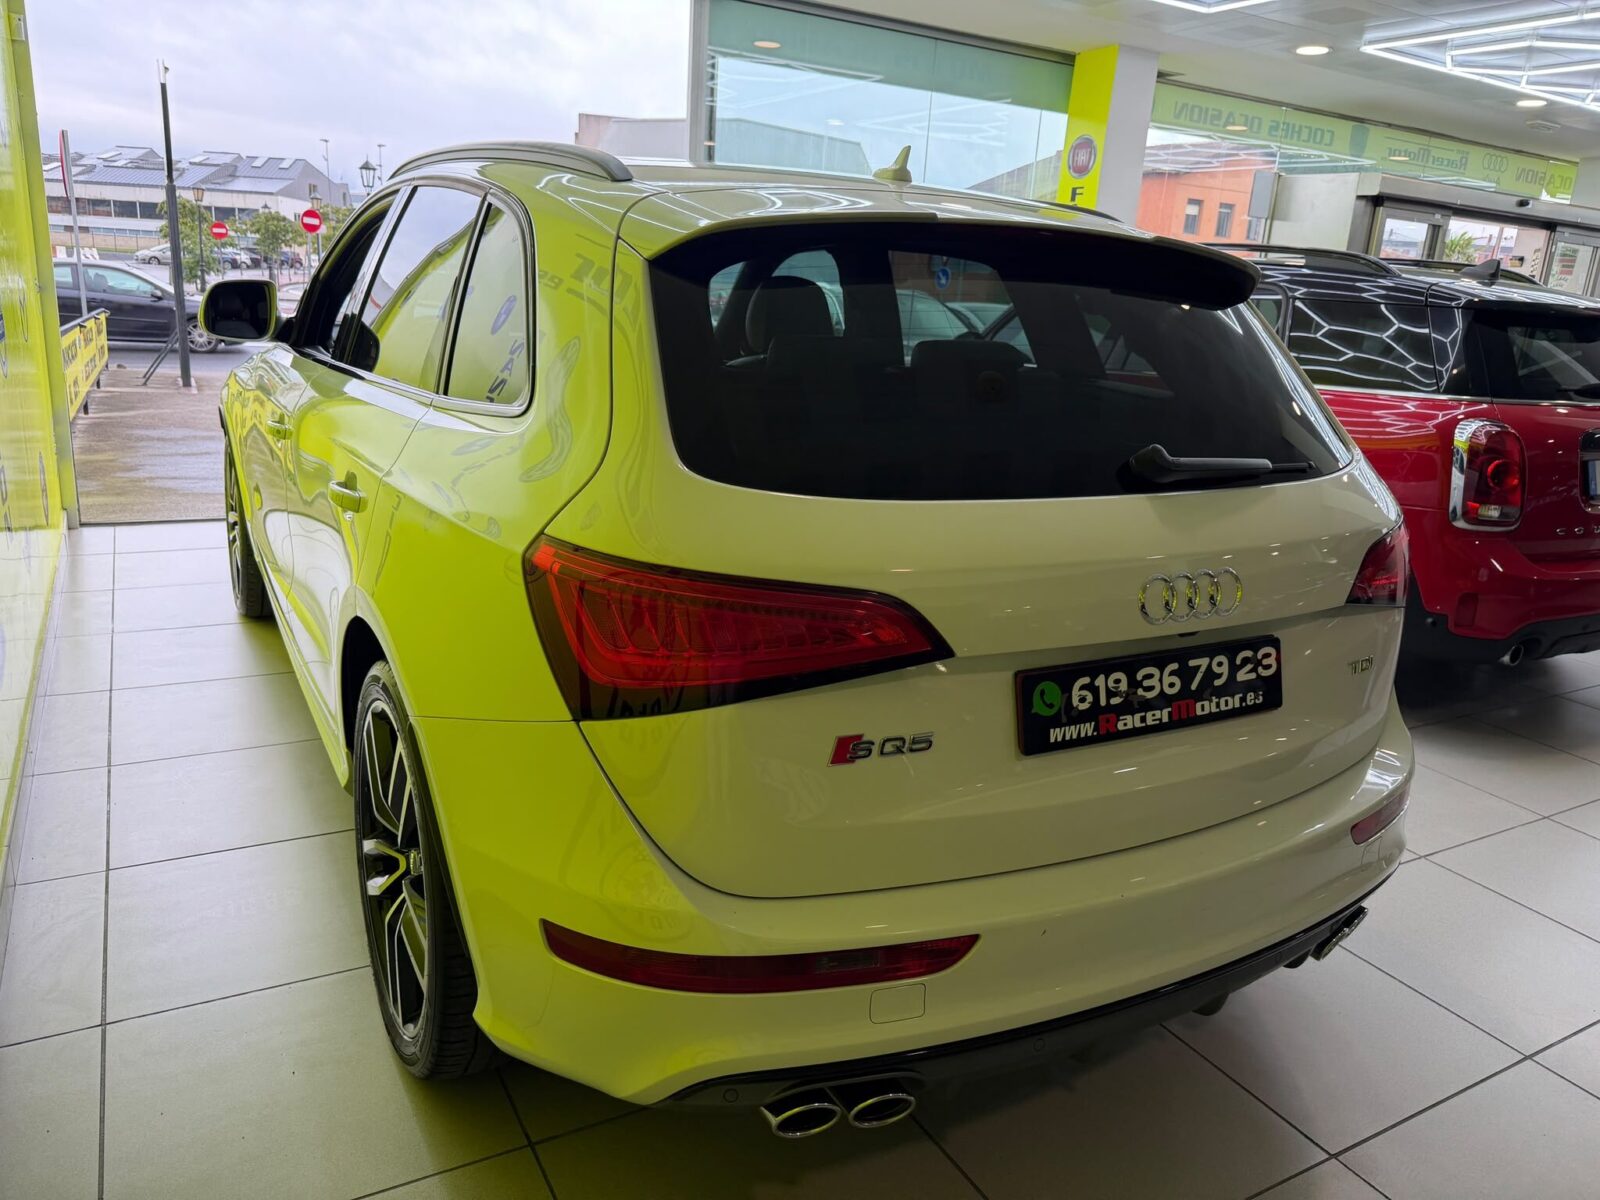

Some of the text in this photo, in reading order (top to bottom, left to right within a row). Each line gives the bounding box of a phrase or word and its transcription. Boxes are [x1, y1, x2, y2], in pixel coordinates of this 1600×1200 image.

[1072, 148, 1091, 166] FIAT
[1071, 646, 1278, 711] 619 36 79 23
[1049, 691, 1264, 743] www.RacerMotor.es
